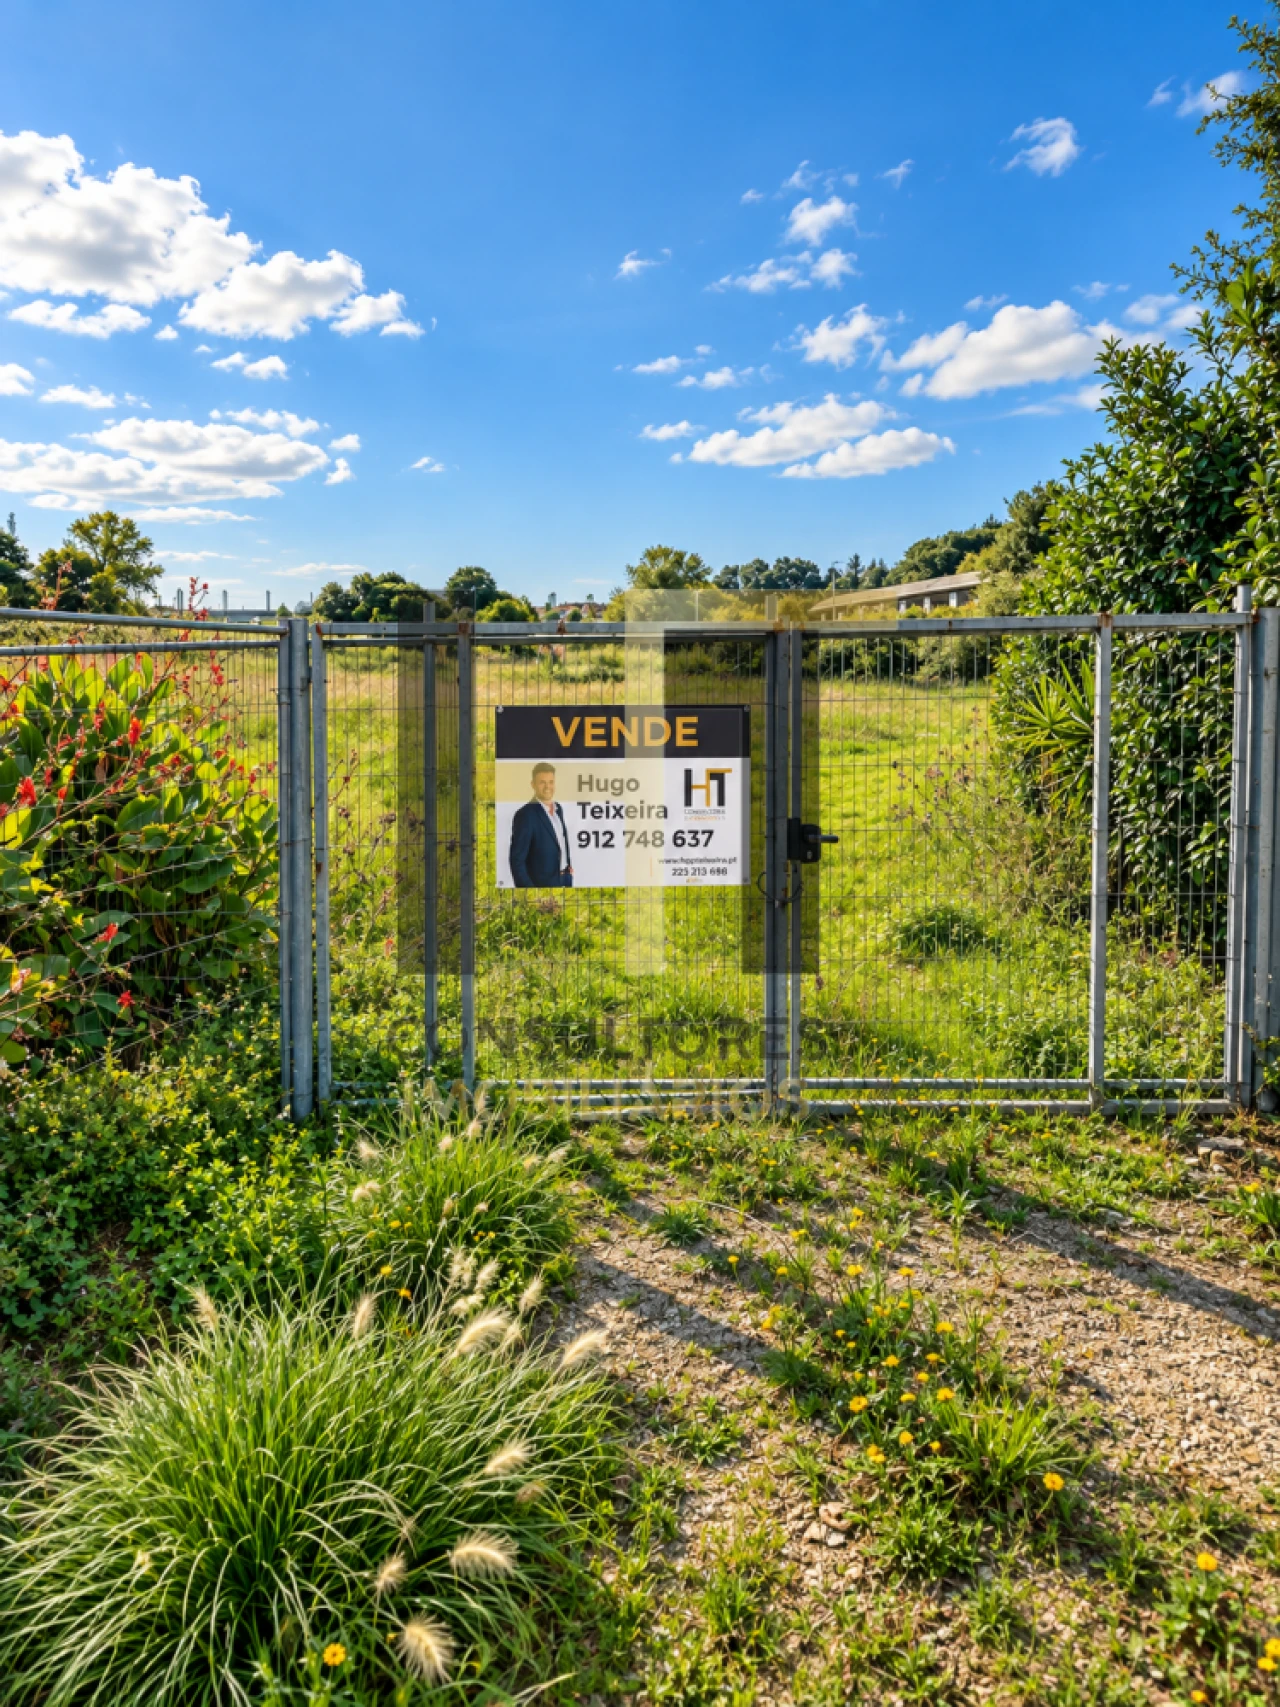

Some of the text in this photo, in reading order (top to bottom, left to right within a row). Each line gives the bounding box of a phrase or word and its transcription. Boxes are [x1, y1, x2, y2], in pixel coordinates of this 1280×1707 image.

[551, 716, 699, 747] VENDE
[577, 775, 640, 796] Hugo
[577, 801, 668, 820] Teixeira
[577, 829, 714, 849] 912 748 637
